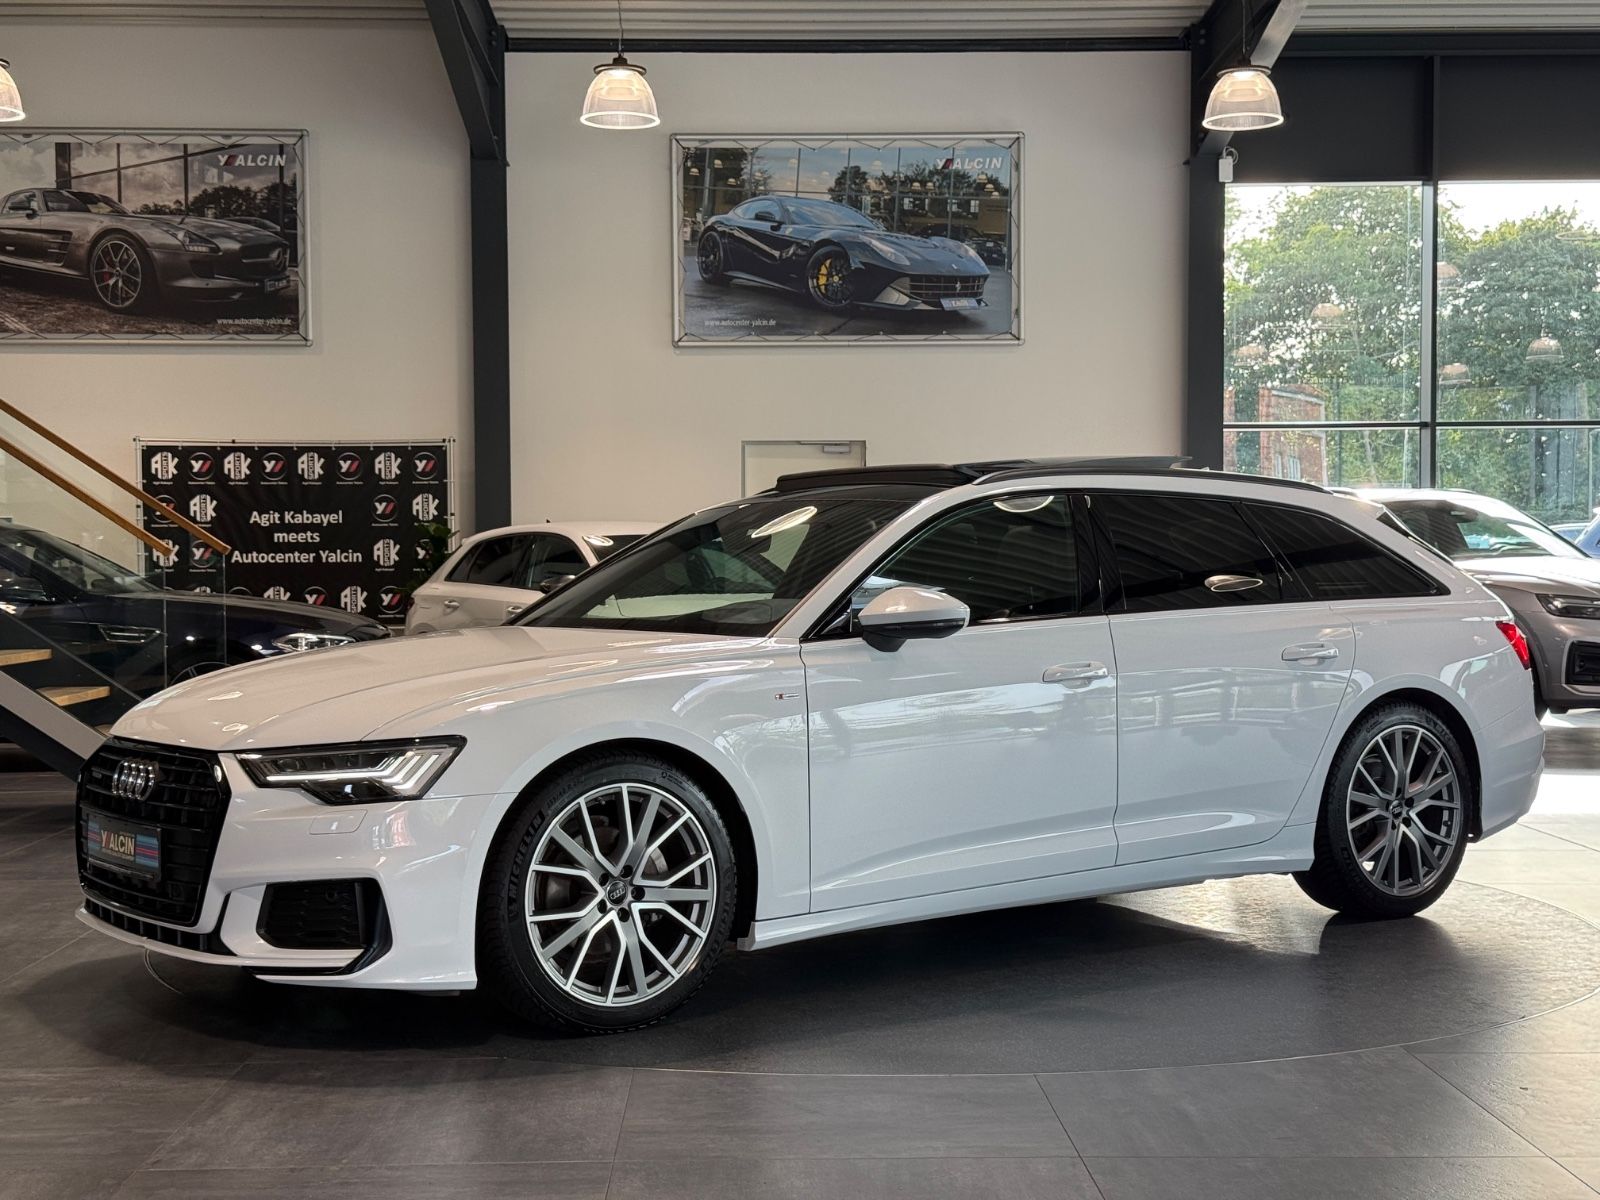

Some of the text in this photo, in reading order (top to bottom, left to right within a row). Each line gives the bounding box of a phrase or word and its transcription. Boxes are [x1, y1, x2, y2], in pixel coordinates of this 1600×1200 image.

[249, 510, 343, 526] Agit Kabayel
[273, 531, 320, 542] meets
[231, 549, 363, 563] Autocenter Yalcin
[508, 813, 544, 903] MICHELIN
